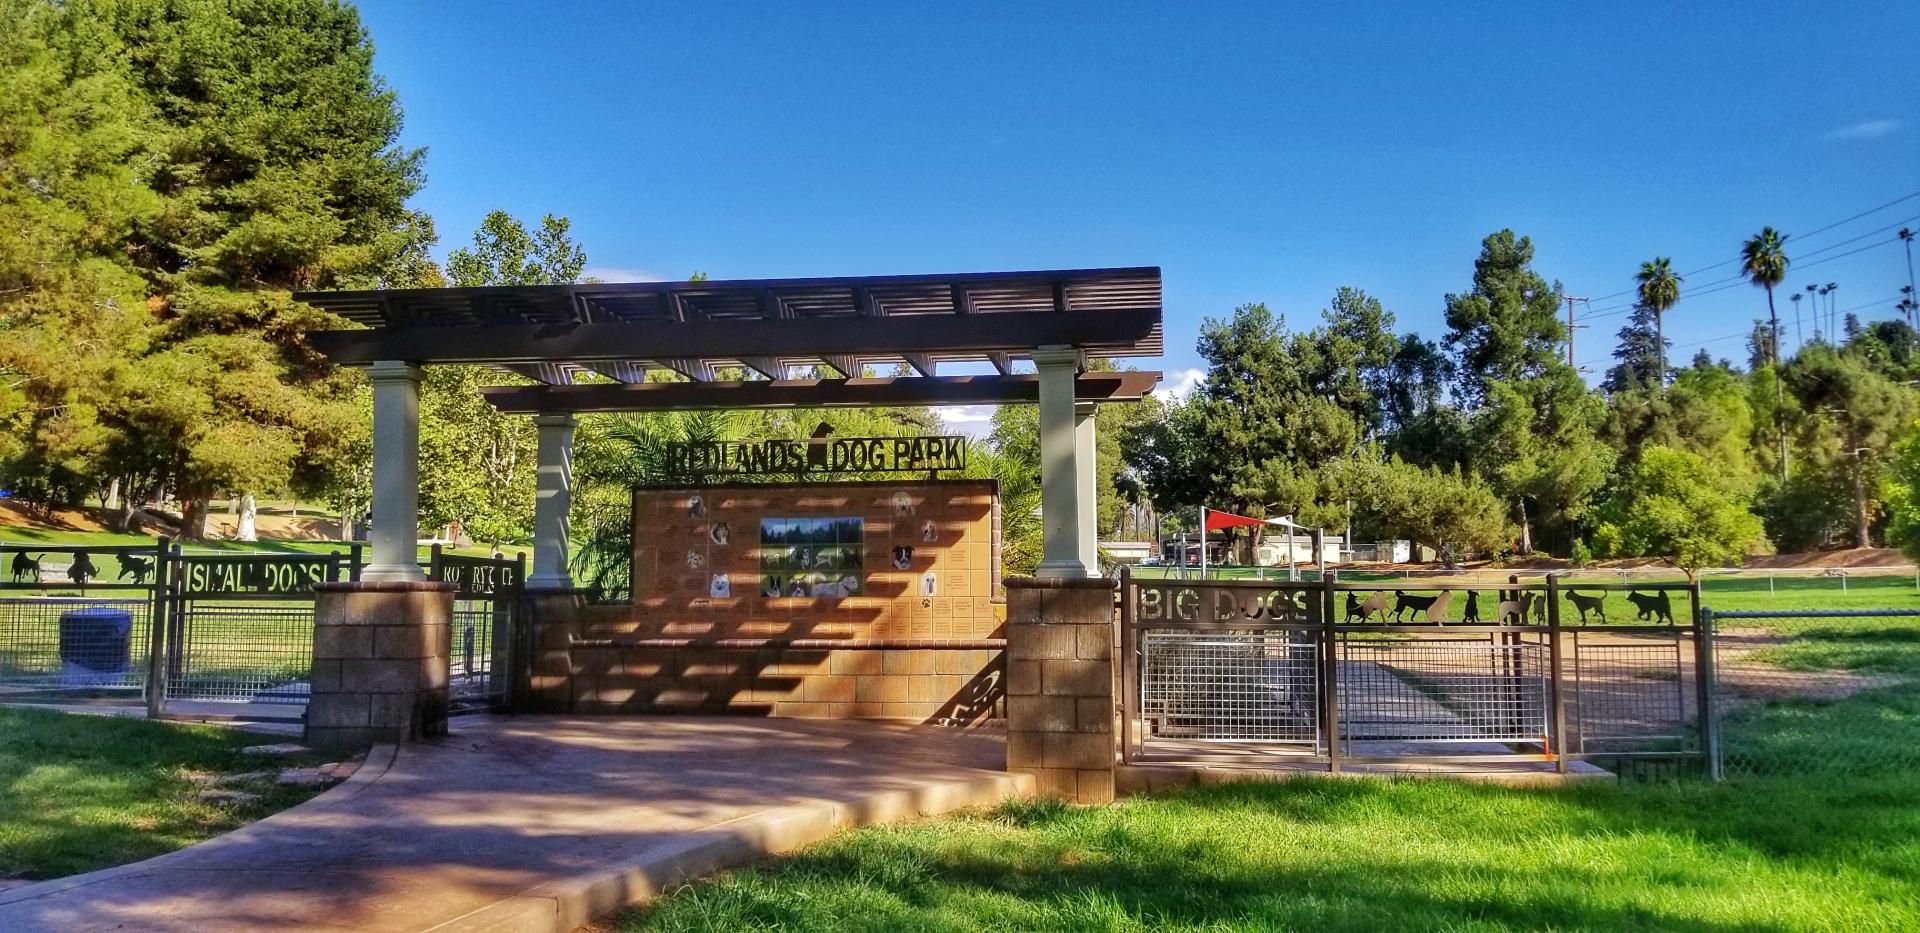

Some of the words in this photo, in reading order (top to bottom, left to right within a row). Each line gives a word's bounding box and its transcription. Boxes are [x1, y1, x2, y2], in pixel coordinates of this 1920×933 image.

[668, 440, 803, 473] REDLANDS
[832, 438, 884, 471] DOG
[894, 436, 963, 470] PARK
[443, 566, 485, 584] RORY
[1141, 588, 1199, 620] BIG
[1214, 589, 1308, 621] DOGS
